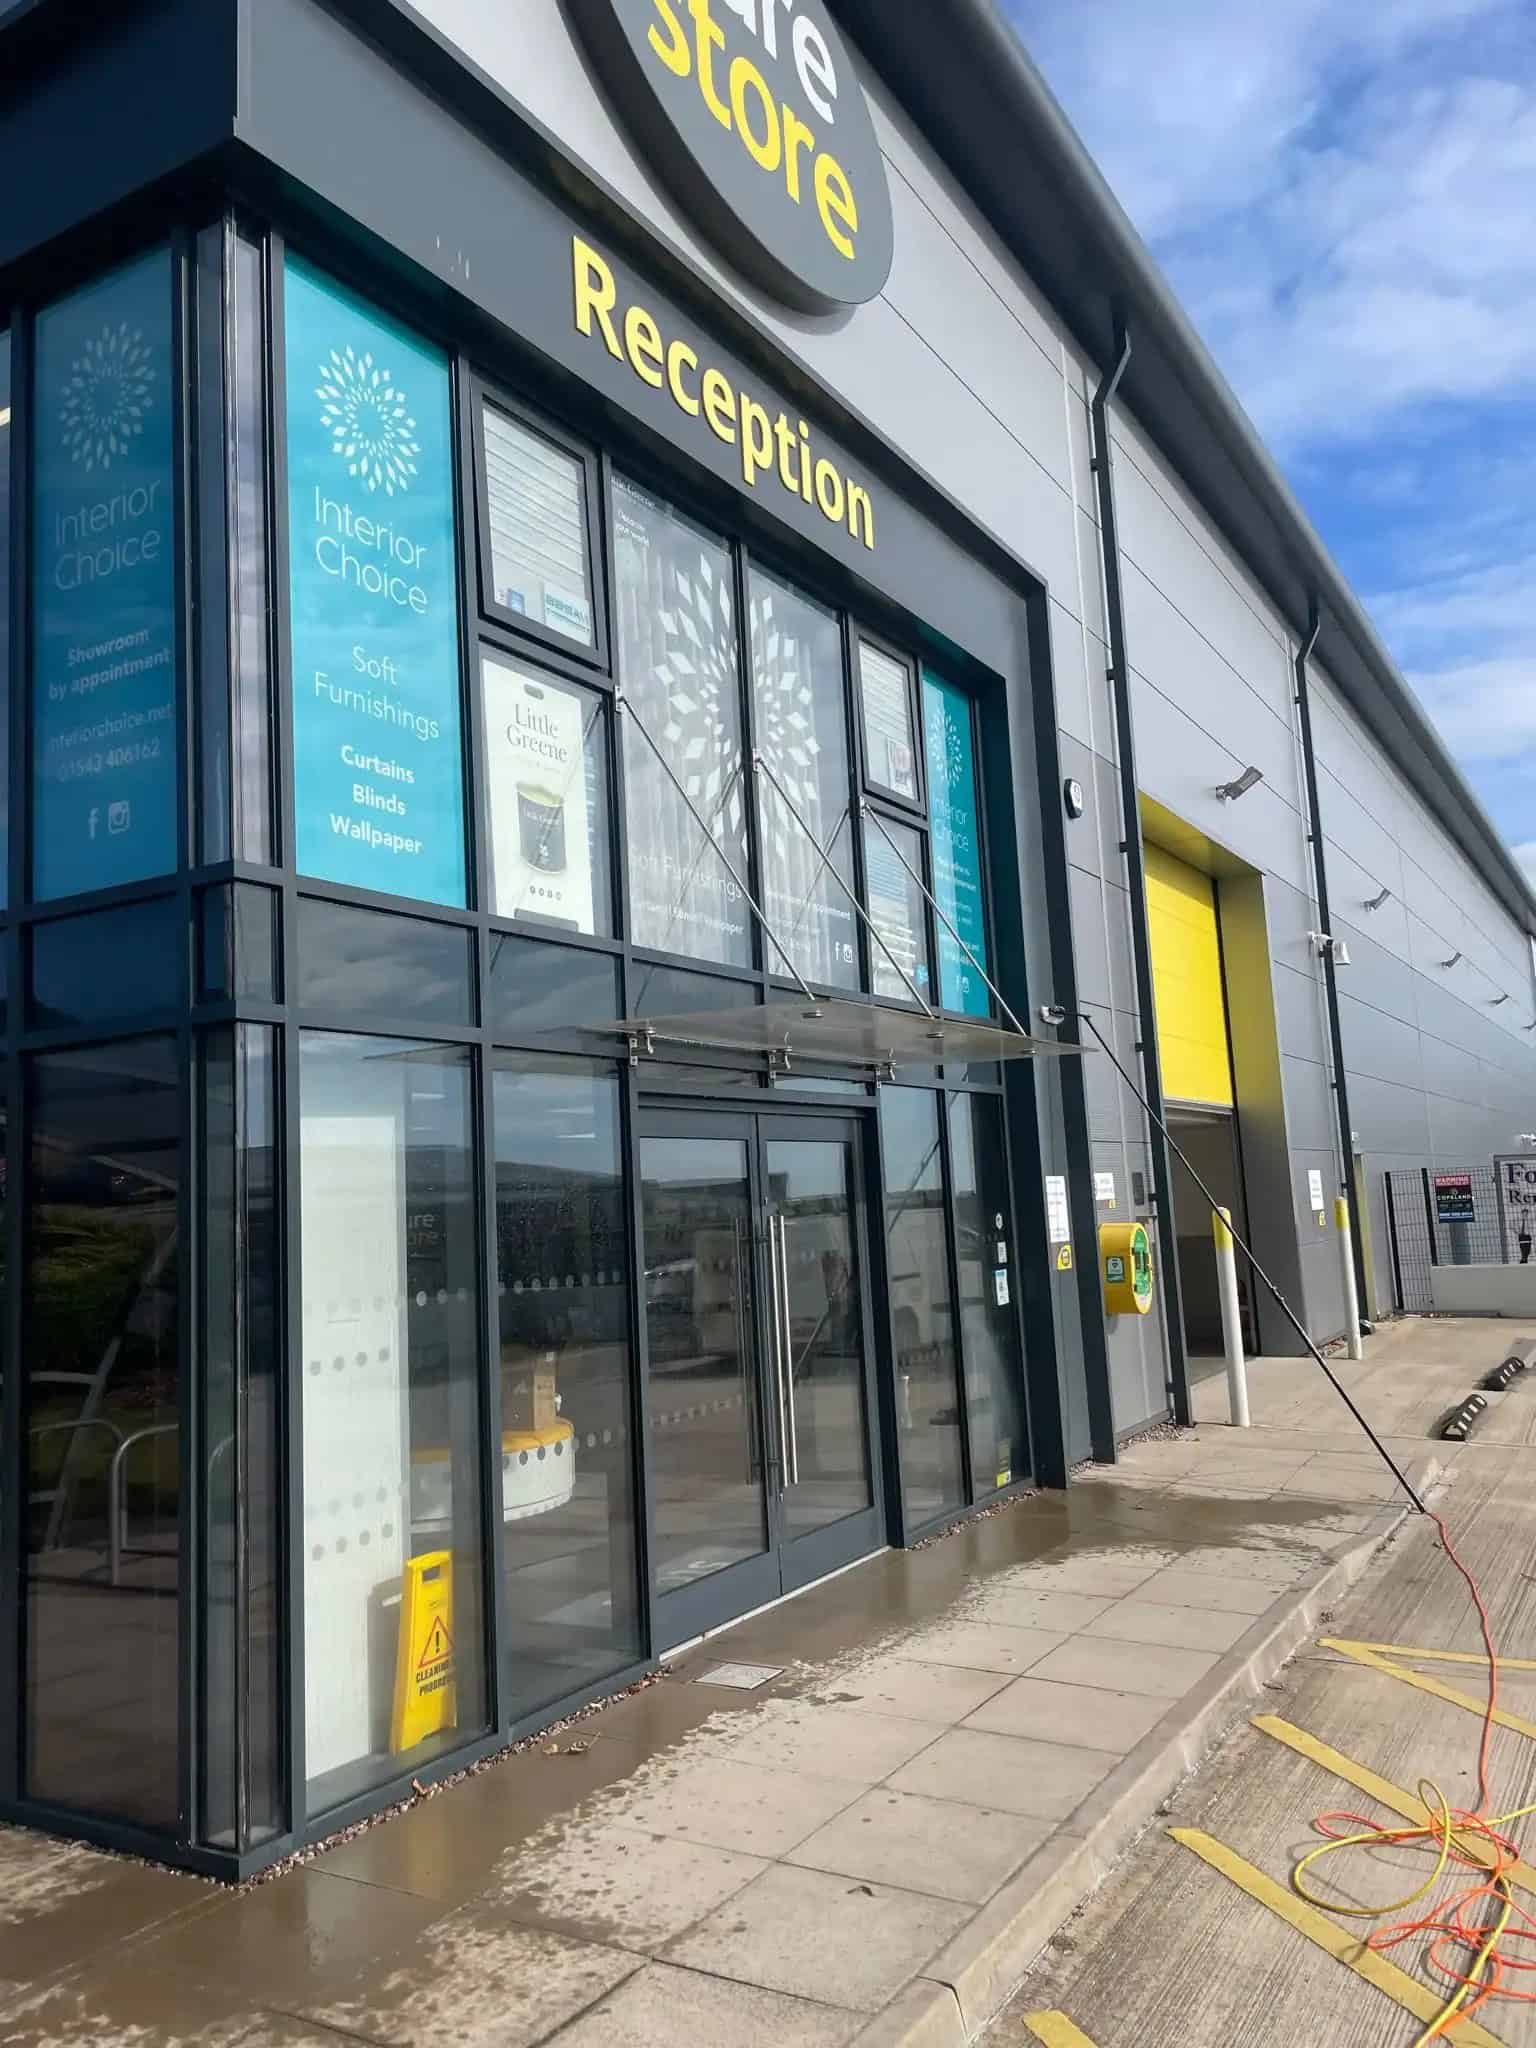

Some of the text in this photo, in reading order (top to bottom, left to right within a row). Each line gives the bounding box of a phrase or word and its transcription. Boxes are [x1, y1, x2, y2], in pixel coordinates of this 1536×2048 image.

[648, 0, 858, 260] store
[572, 234, 876, 551] Reception
[56, 479, 160, 547] Interior
[315, 485, 427, 569] Interior
[56, 528, 160, 591] Choice
[316, 546, 428, 614] Choice
[48, 647, 171, 701] by appointment
[67, 629, 150, 667] Showroom
[352, 645, 398, 686] Soft
[314, 671, 440, 742] Furnishings
[515, 703, 560, 740] Little
[341, 745, 415, 784] Curtains
[506, 723, 569, 763] Greene
[352, 783, 405, 816] Blinds
[330, 813, 422, 855] Wallpaper
